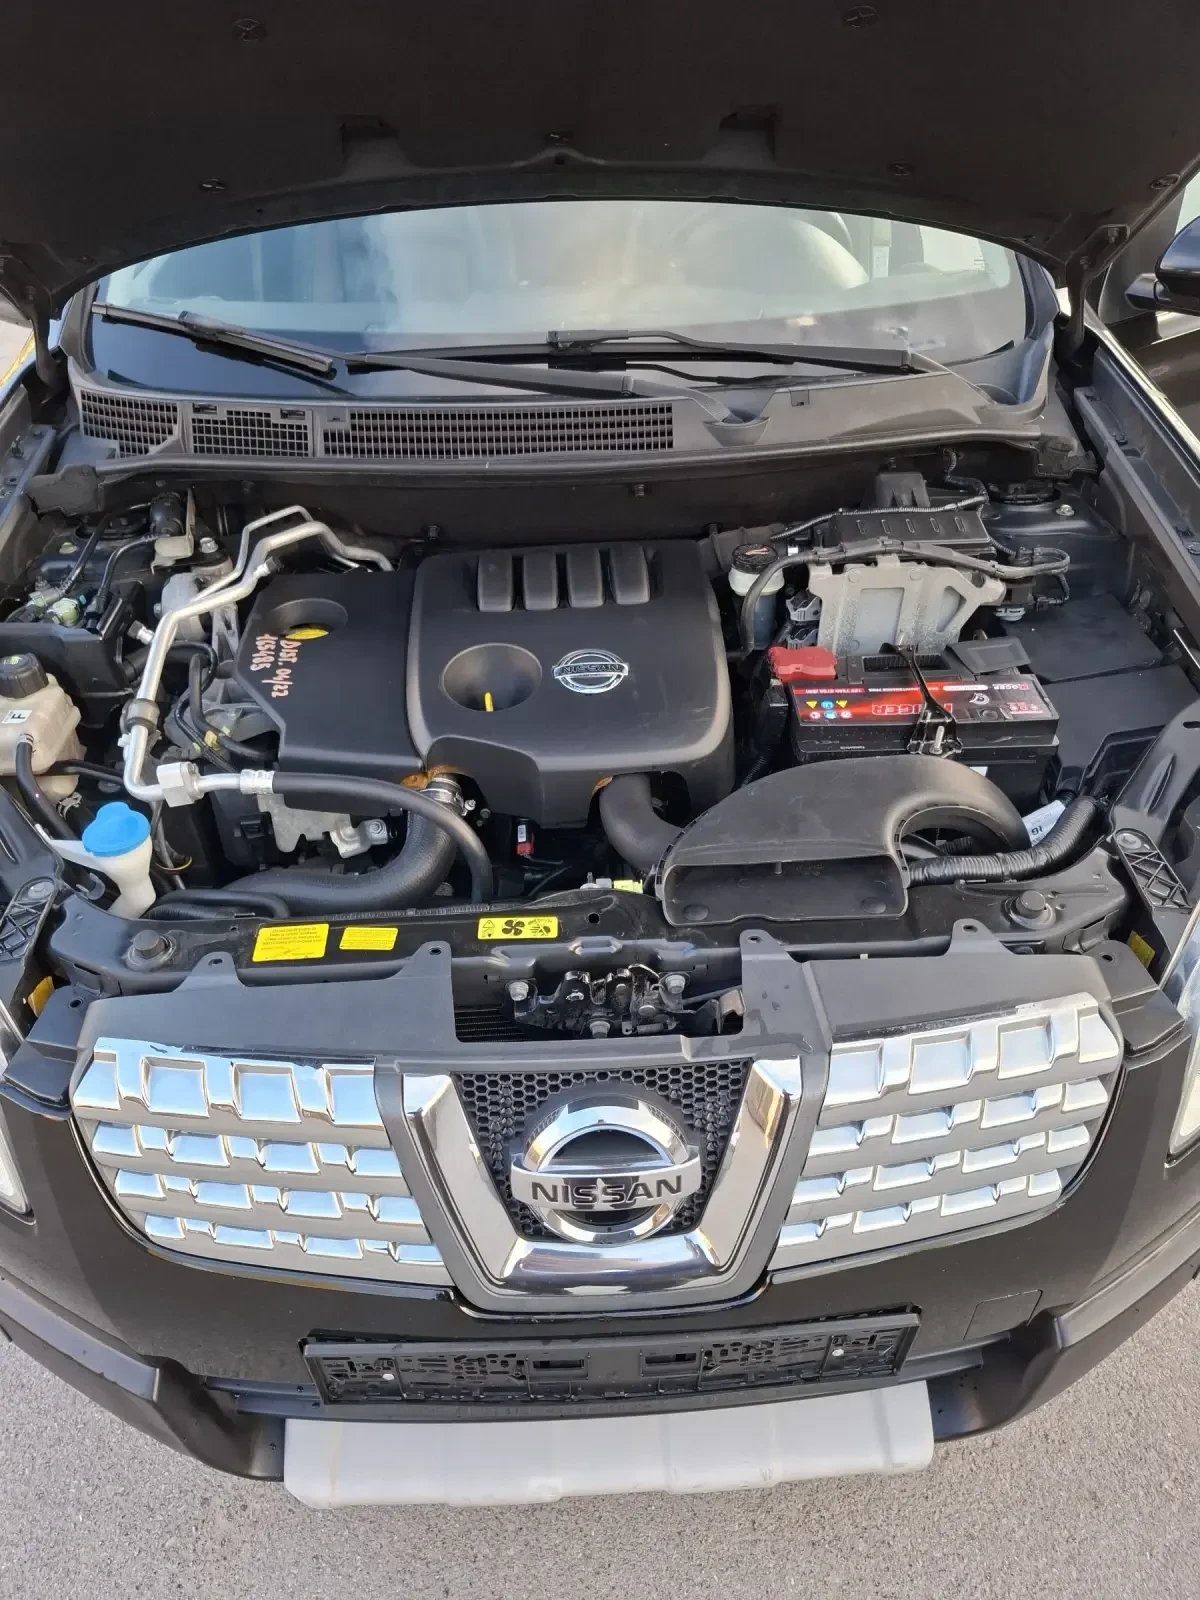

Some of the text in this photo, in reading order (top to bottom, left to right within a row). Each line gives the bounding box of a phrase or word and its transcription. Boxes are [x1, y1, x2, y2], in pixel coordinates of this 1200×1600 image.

[261, 668, 293, 698] 04/22
[561, 663, 621, 674] NISSAN
[531, 1175, 682, 1205] NISSAN
